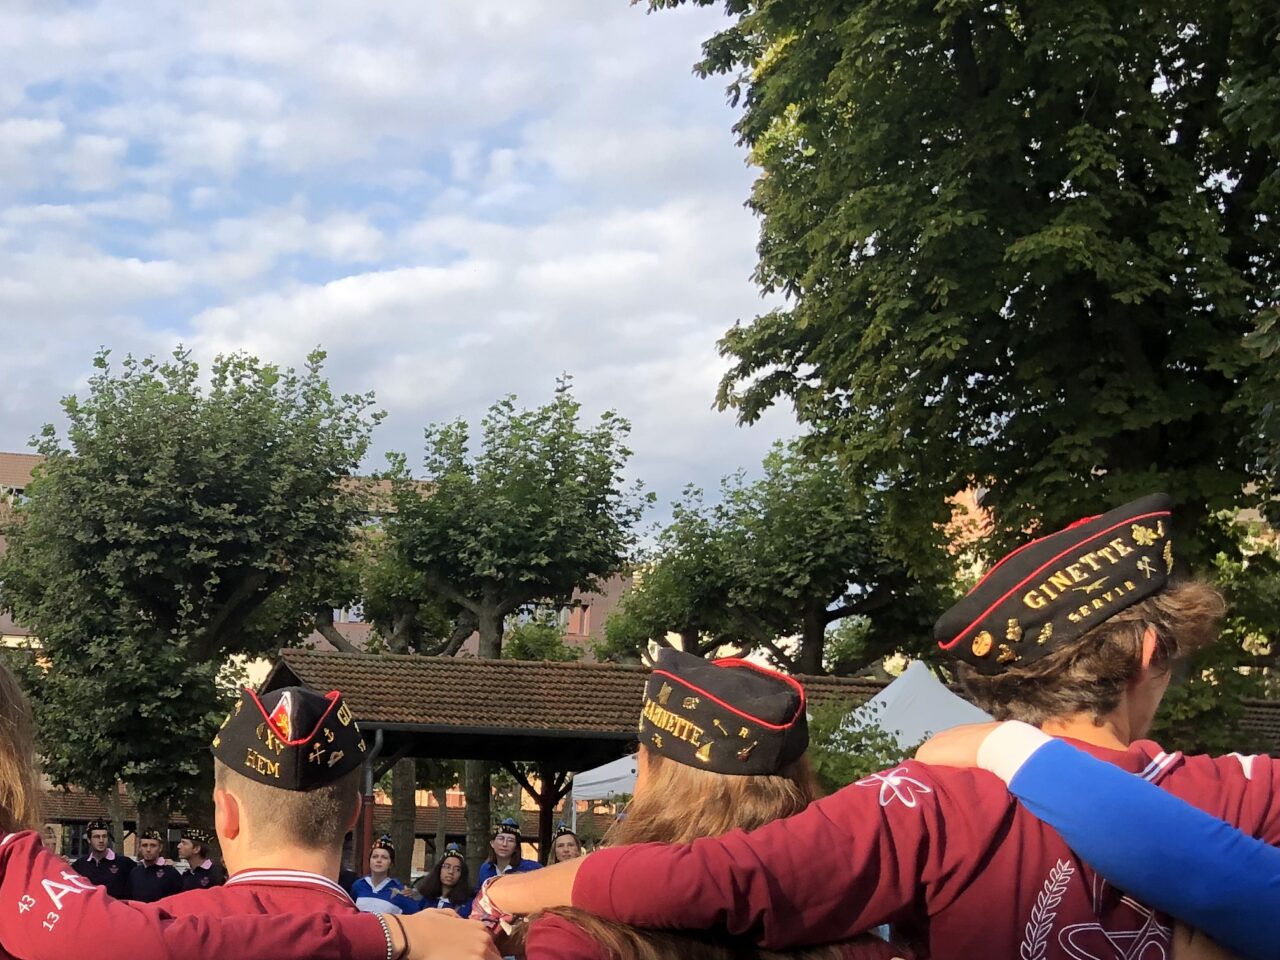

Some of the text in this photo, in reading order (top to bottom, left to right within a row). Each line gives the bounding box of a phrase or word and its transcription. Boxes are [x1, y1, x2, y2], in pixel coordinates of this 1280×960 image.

[1022, 537, 1135, 610] GINETTE
[1067, 580, 1137, 624] SERVIR
[243, 747, 281, 778] HEM
[17, 894, 36, 914] 43
[41, 870, 97, 910] At
[42, 911, 60, 932] 13
